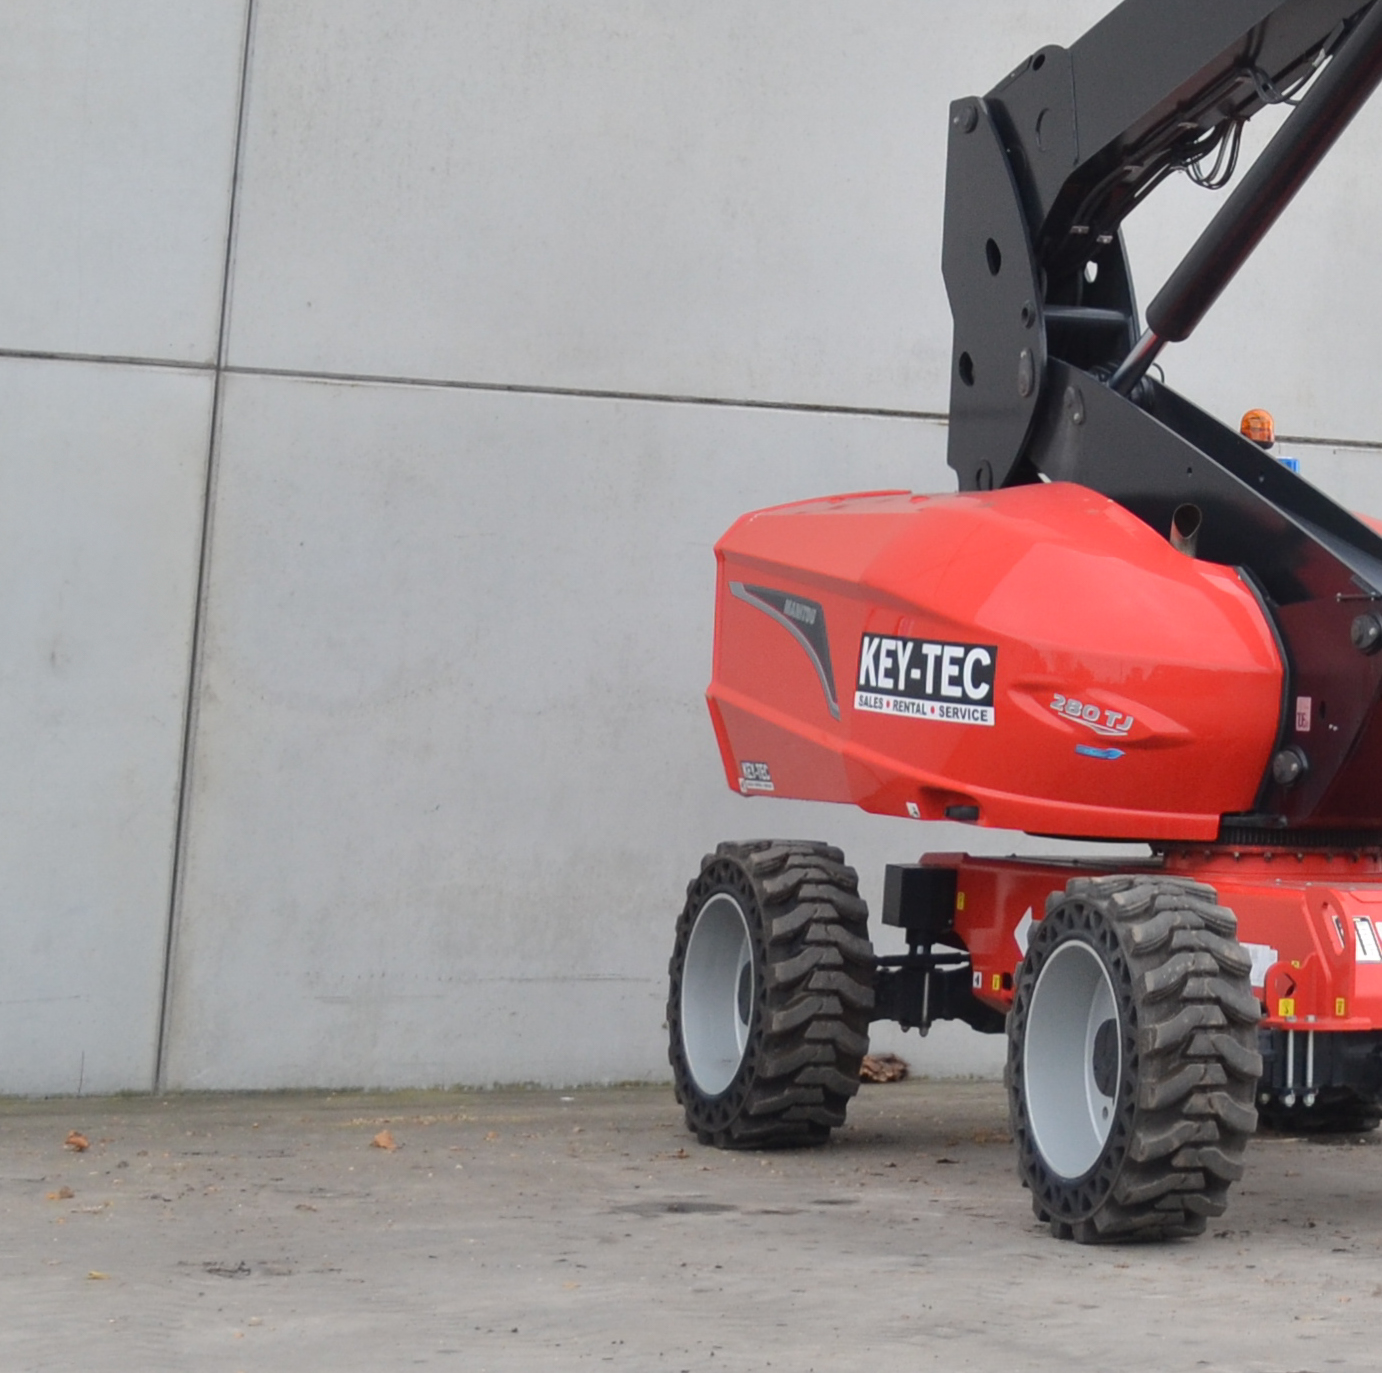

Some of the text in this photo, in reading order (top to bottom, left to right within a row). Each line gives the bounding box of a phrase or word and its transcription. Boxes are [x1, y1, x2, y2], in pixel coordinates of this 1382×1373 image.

[783, 598, 817, 625] MANITOU
[858, 636, 992, 701] KEY-TEC
[858, 694, 989, 722] SALES RENTAL SERVICE
[1050, 693, 1134, 731] 280 TJ
[741, 761, 771, 781] KEY-TEC
